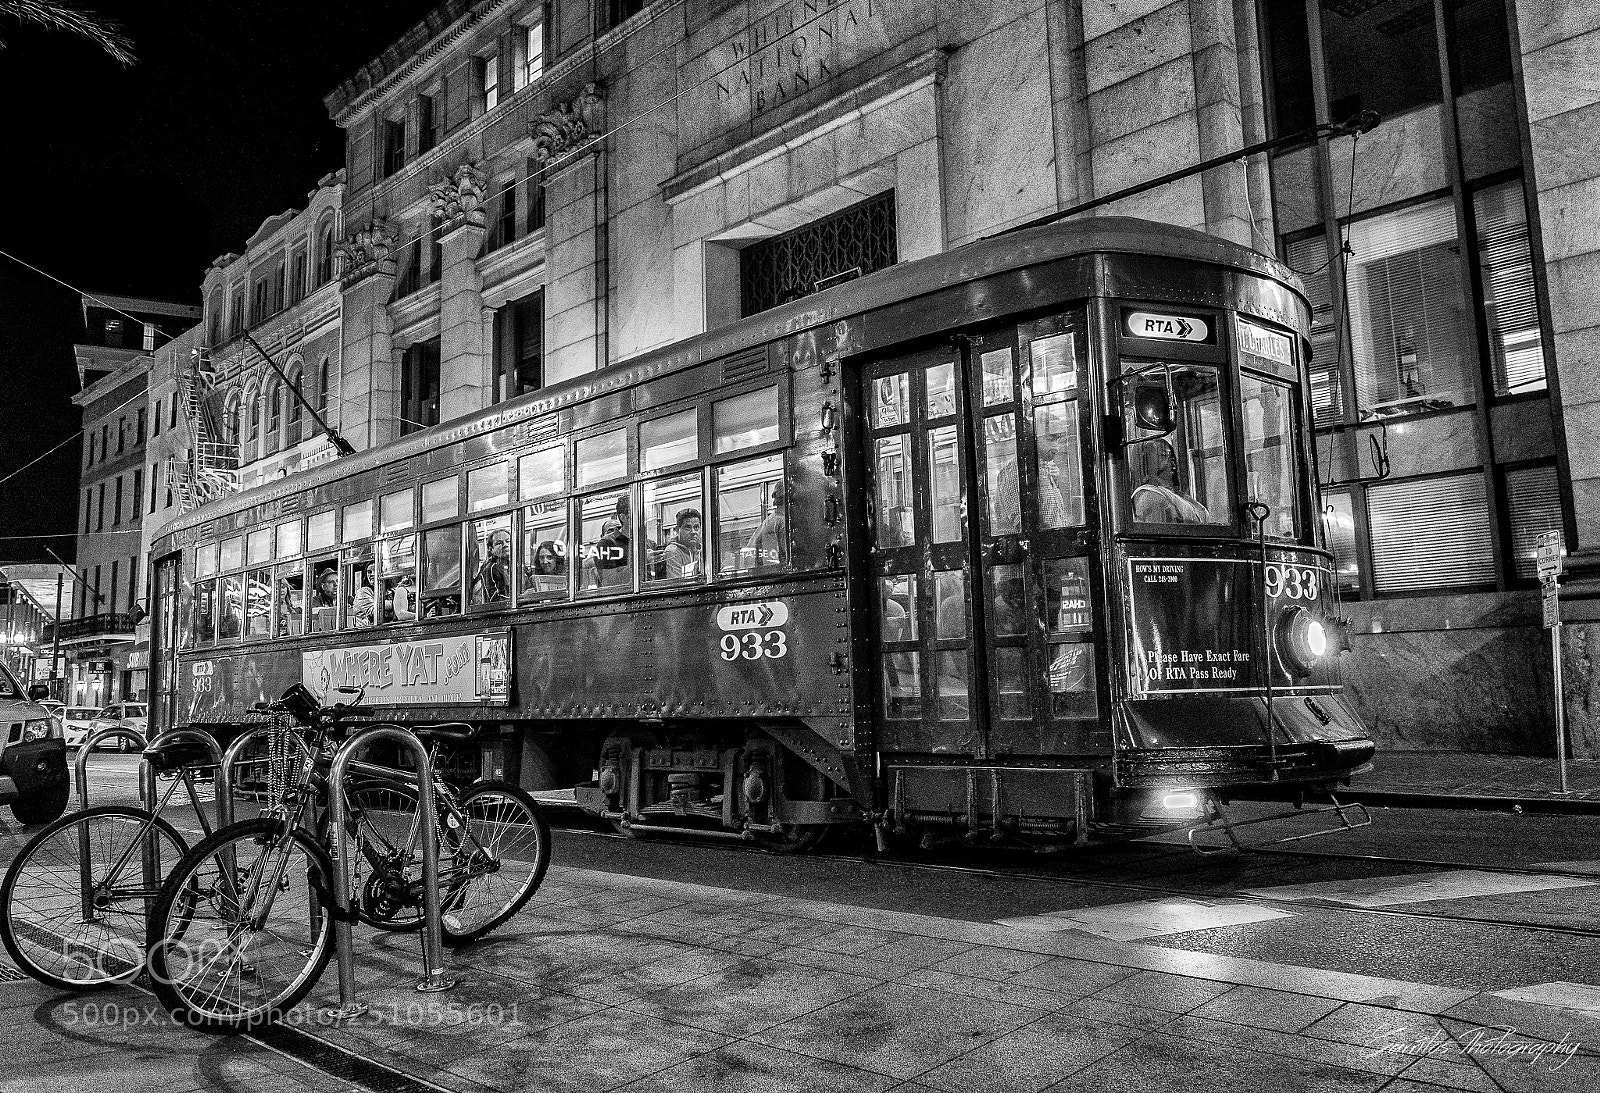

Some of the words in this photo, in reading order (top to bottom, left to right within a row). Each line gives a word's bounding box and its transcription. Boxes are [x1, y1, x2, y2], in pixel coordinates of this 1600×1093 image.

[756, 58, 831, 110] BANK
[1145, 318, 1174, 334] RTA
[1143, 574, 1158, 583] CALL
[1265, 566, 1318, 600] 933
[730, 609, 756, 625] RTA
[720, 630, 788, 661] 933
[1180, 650, 1204, 663] Have
[1206, 649, 1231, 662] Exact
[1232, 649, 1250, 662] Fare
[328, 645, 395, 690] WHERE
[395, 642, 444, 687] YAT
[1166, 667, 1188, 680] RTA
[1189, 666, 1209, 679] Pass
[1211, 666, 1237, 681] Ready
[192, 676, 212, 693] 933
